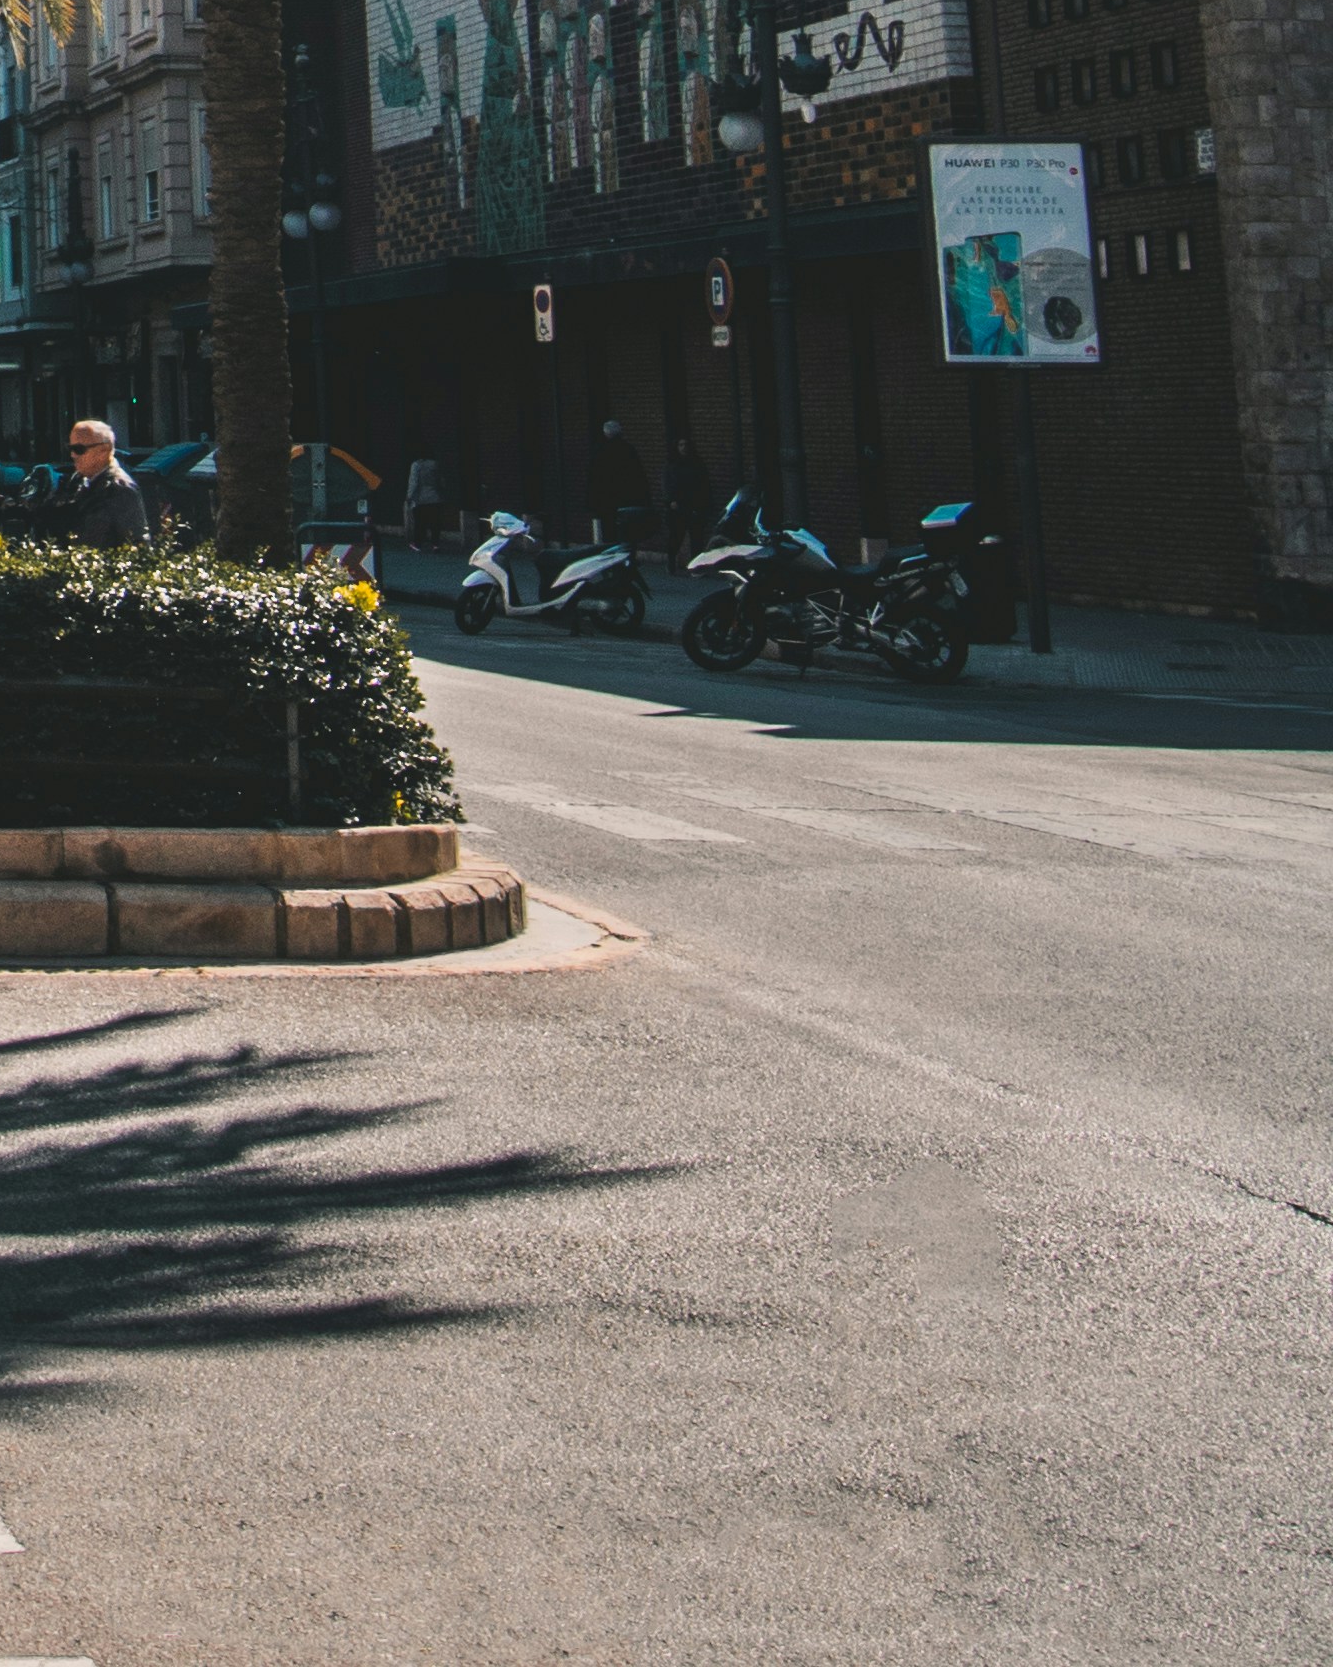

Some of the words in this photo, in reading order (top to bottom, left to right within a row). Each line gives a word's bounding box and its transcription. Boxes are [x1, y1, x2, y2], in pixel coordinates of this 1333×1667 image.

[944, 159, 996, 169] HUAWEI
[1000, 159, 1020, 169] P30
[1049, 159, 1066, 169] Pro
[975, 185, 1043, 194] REESCRIBE
[961, 196, 984, 205] LAS
[989, 196, 1037, 205] REGLAS
[1042, 196, 1058, 205] DE
[956, 207, 972, 215] LA
